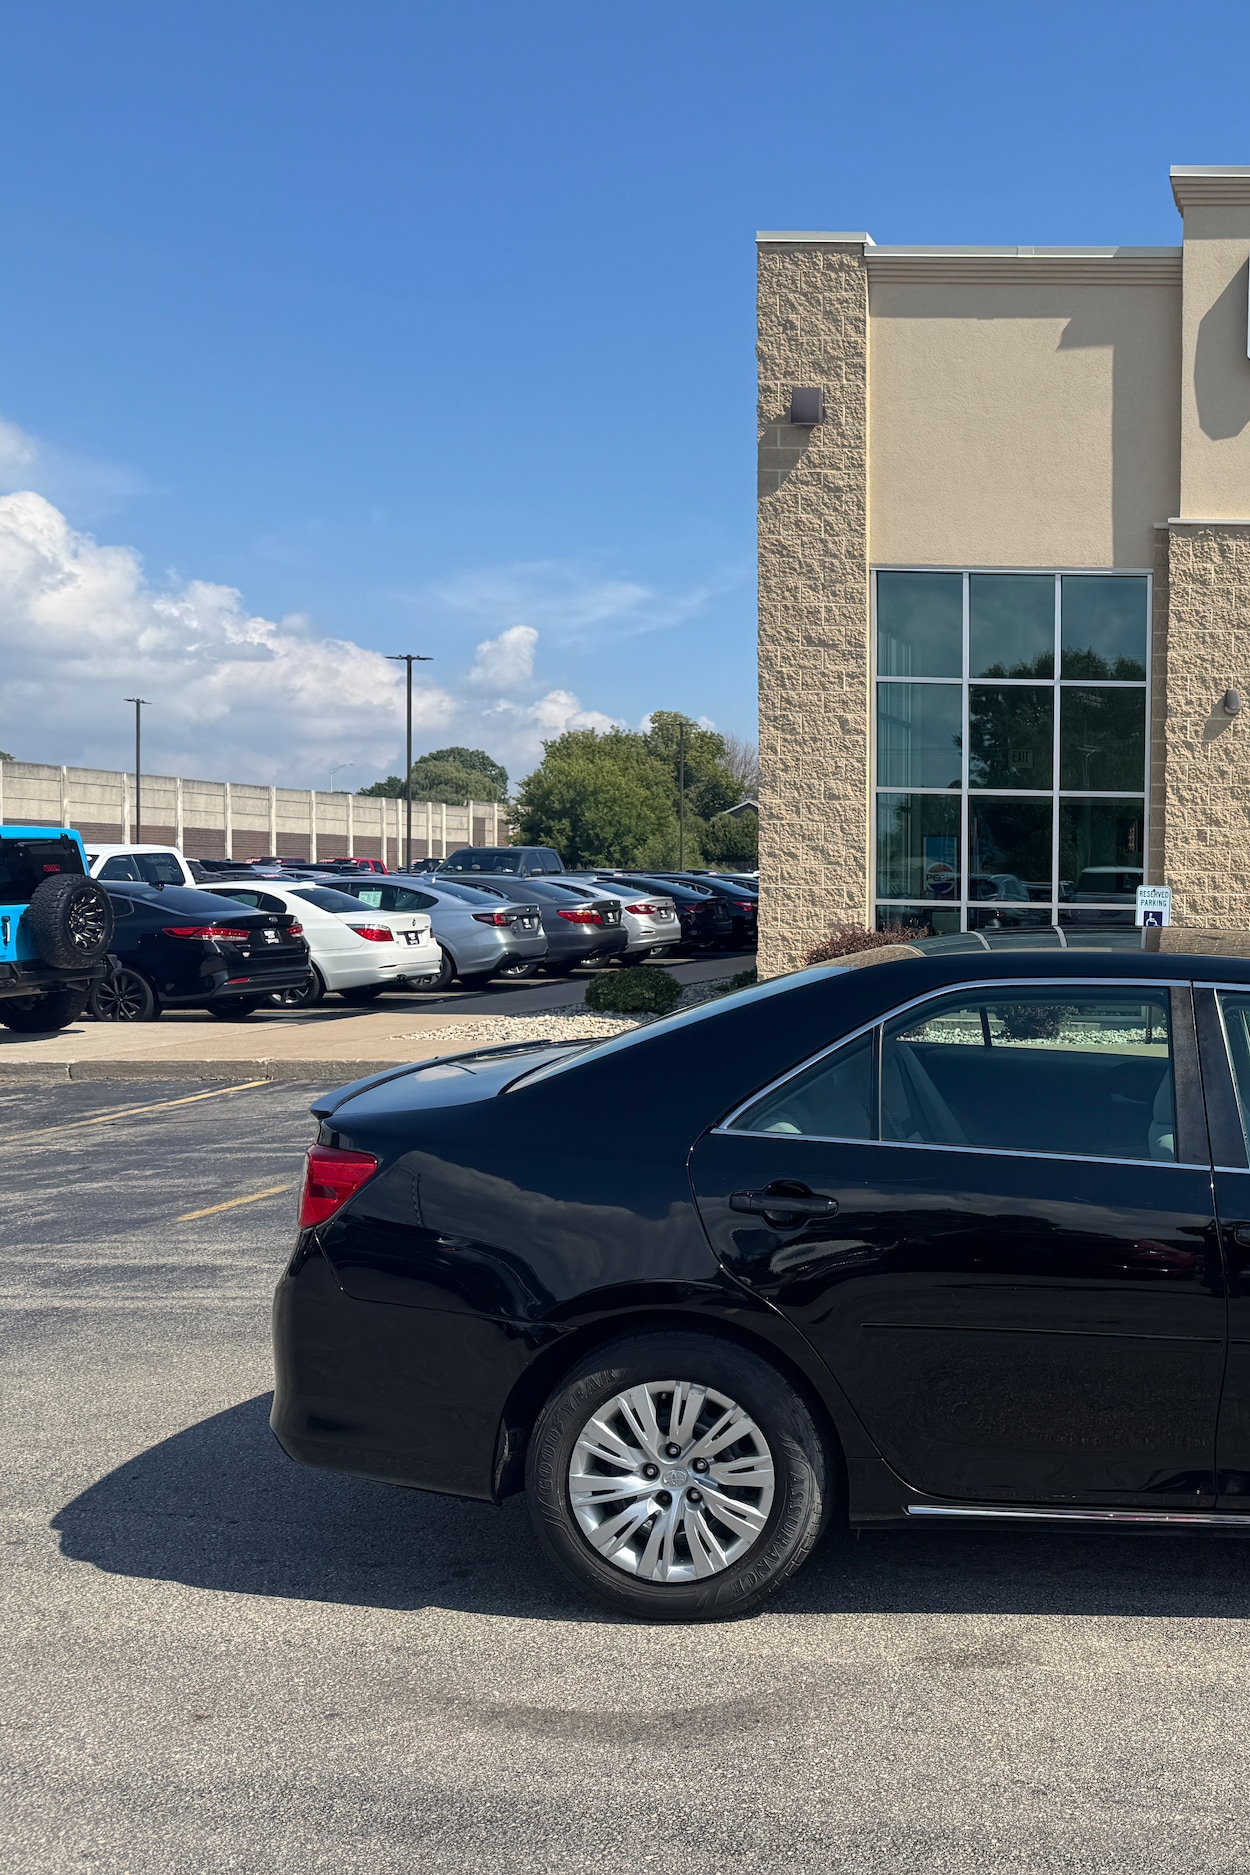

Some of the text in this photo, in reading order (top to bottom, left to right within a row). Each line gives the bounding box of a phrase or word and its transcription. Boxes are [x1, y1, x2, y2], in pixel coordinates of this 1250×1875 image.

[1012, 750, 1029, 763] EXIT
[1139, 890, 1169, 898] RESERVED
[729, 1471, 805, 1597] ASSURANCE
